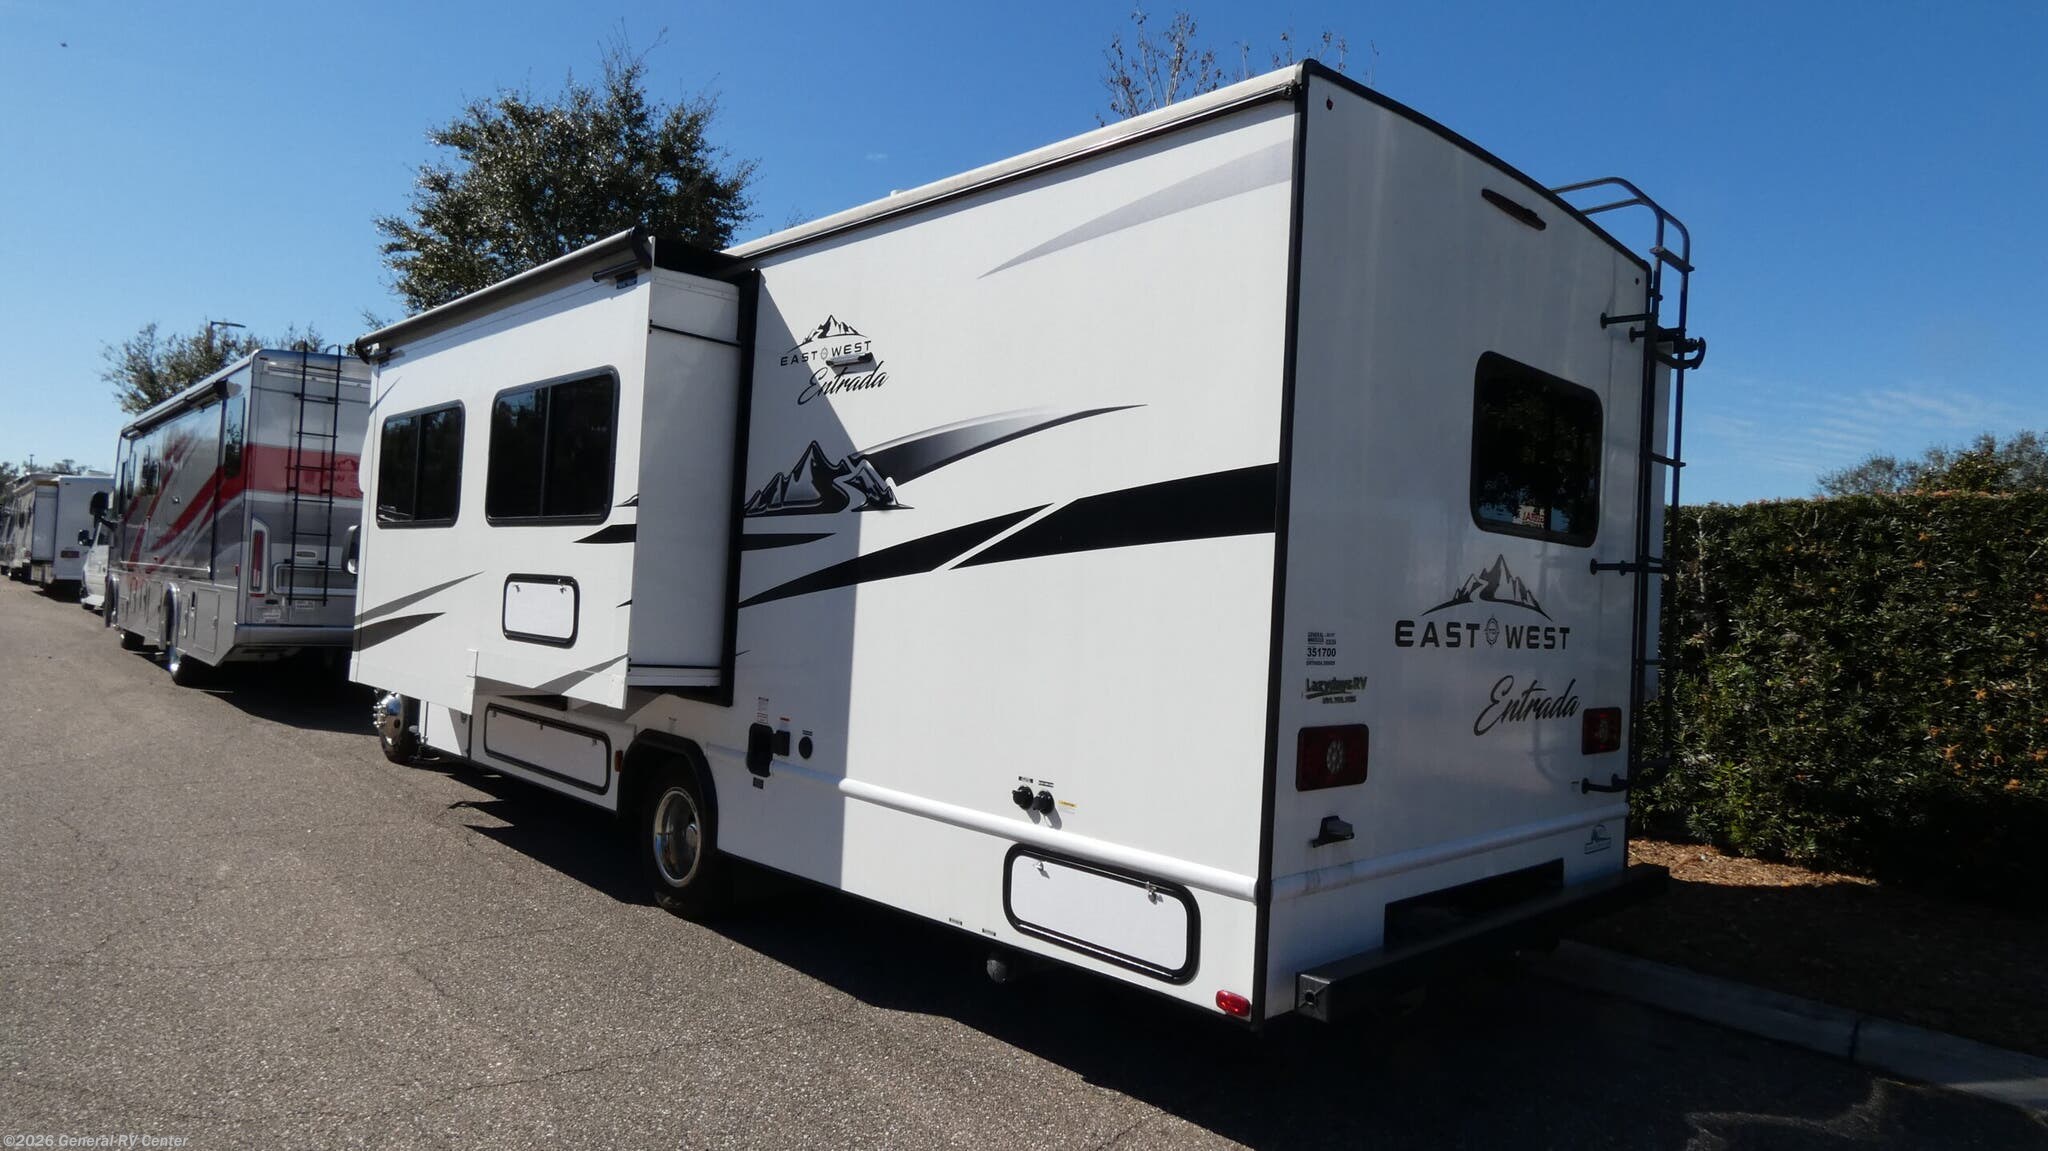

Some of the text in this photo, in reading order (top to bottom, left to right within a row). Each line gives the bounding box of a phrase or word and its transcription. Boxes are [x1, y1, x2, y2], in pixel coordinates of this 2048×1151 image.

[780, 341, 872, 366] EAST WEST
[797, 361, 889, 405] Entrada
[1395, 620, 1572, 650] EAST WEST
[1307, 647, 1337, 657] 351700
[1474, 675, 1580, 736] Entrada
